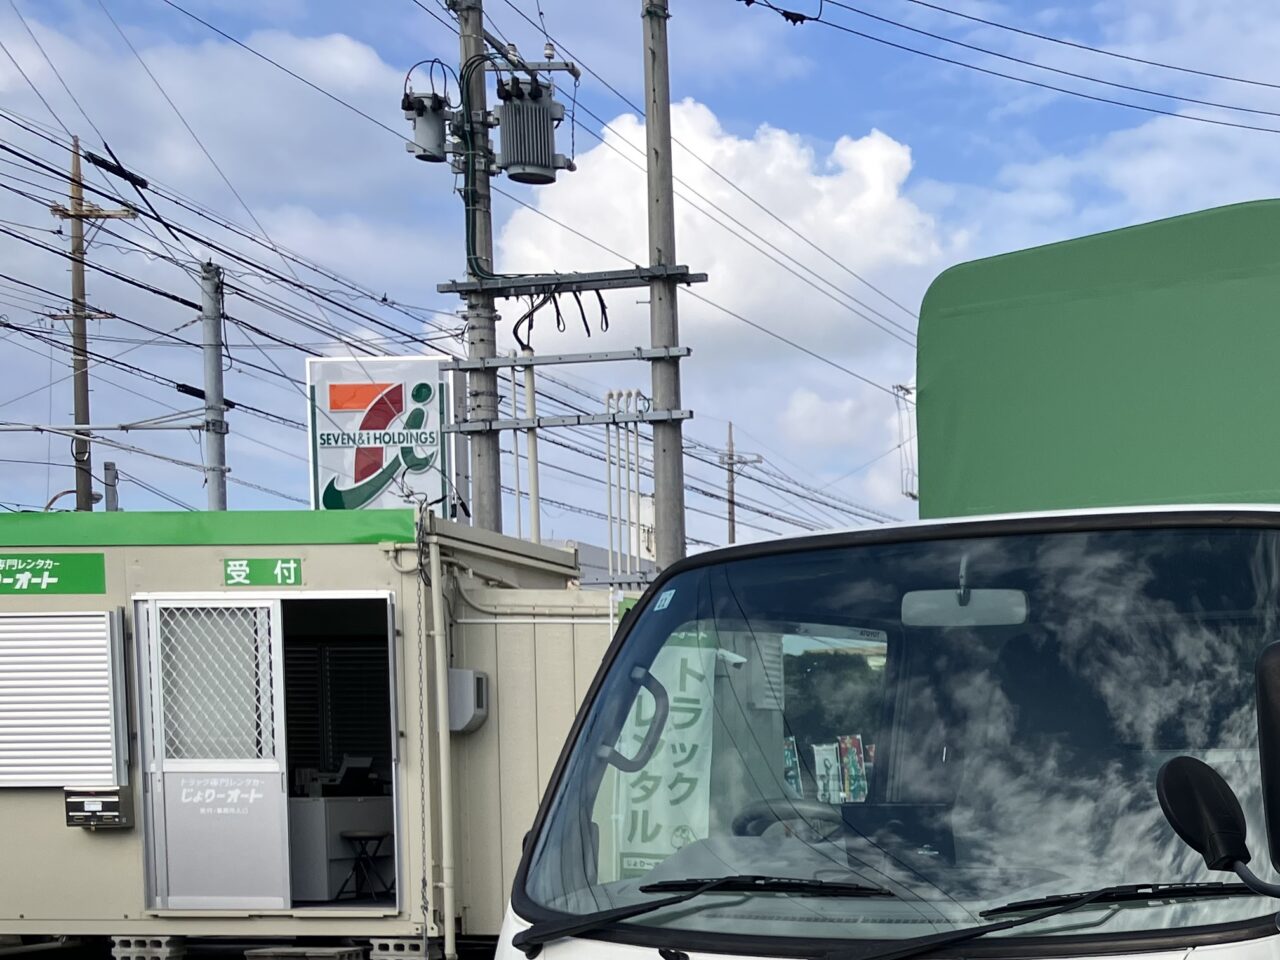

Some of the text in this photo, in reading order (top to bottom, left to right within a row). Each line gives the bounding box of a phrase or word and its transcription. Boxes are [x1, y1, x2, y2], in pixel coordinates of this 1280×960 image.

[373, 431, 436, 445] HOLDINGS
[0, 571, 59, 590] ーオート
[226, 559, 298, 585] 受付
[667, 657, 706, 807] トラック
